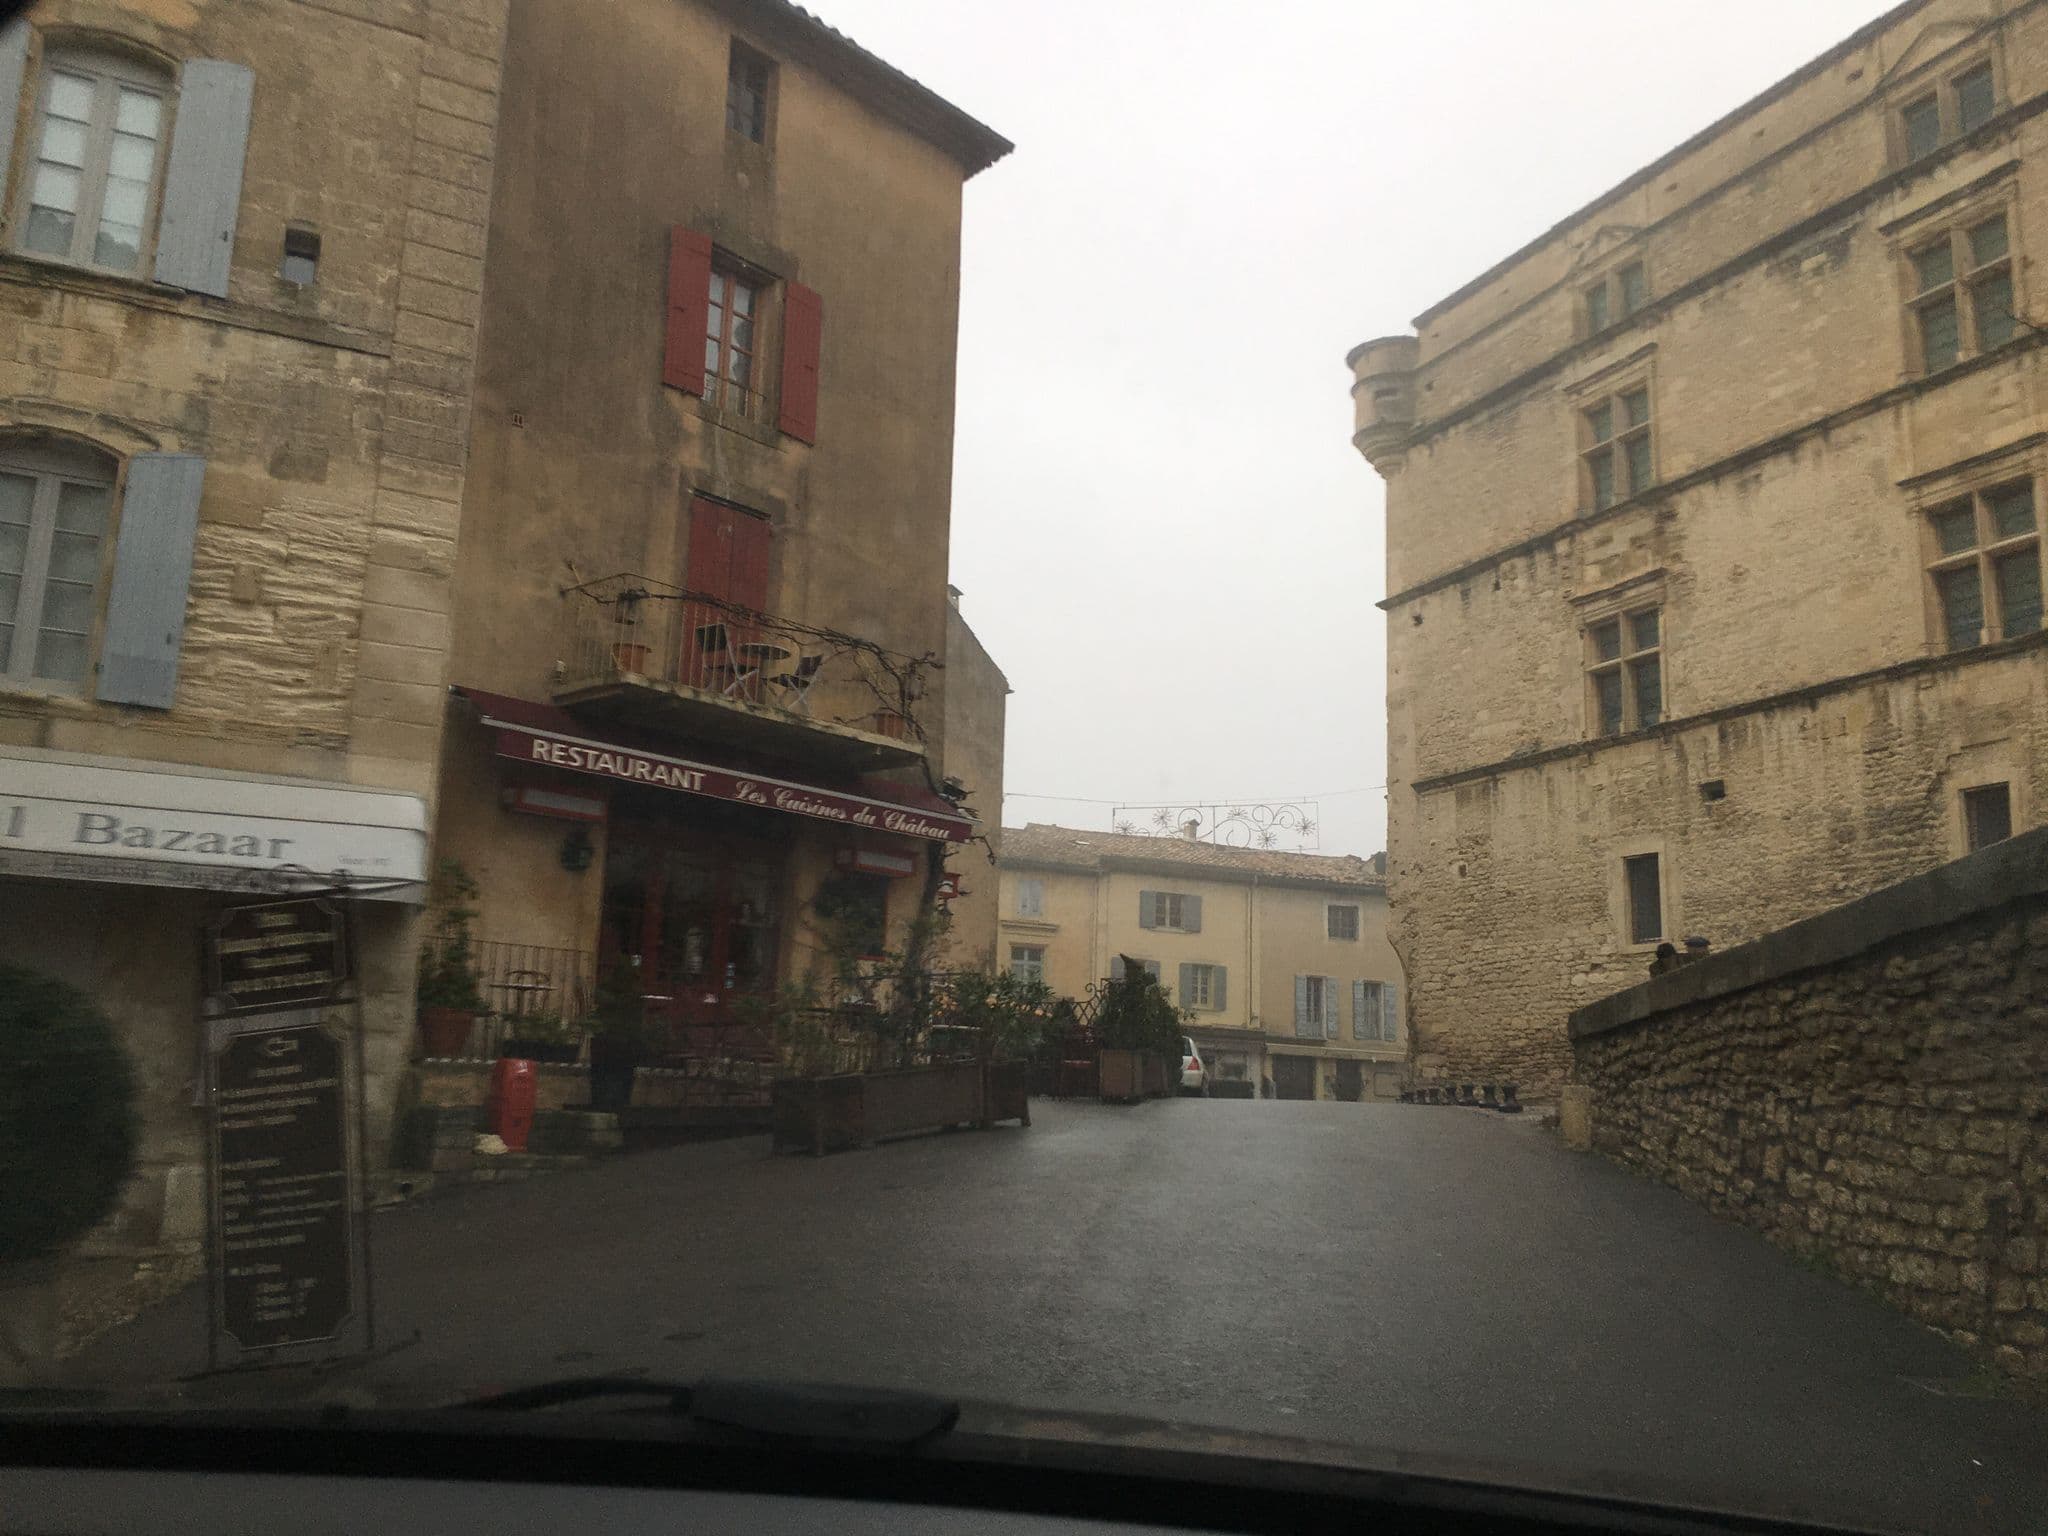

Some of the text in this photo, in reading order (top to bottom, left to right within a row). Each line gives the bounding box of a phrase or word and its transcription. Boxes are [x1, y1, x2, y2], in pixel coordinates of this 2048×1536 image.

[532, 738, 706, 791] RESTAURANT
[72, 811, 296, 859] Bazaar
[734, 780, 950, 839] Les Cuisines du Château
